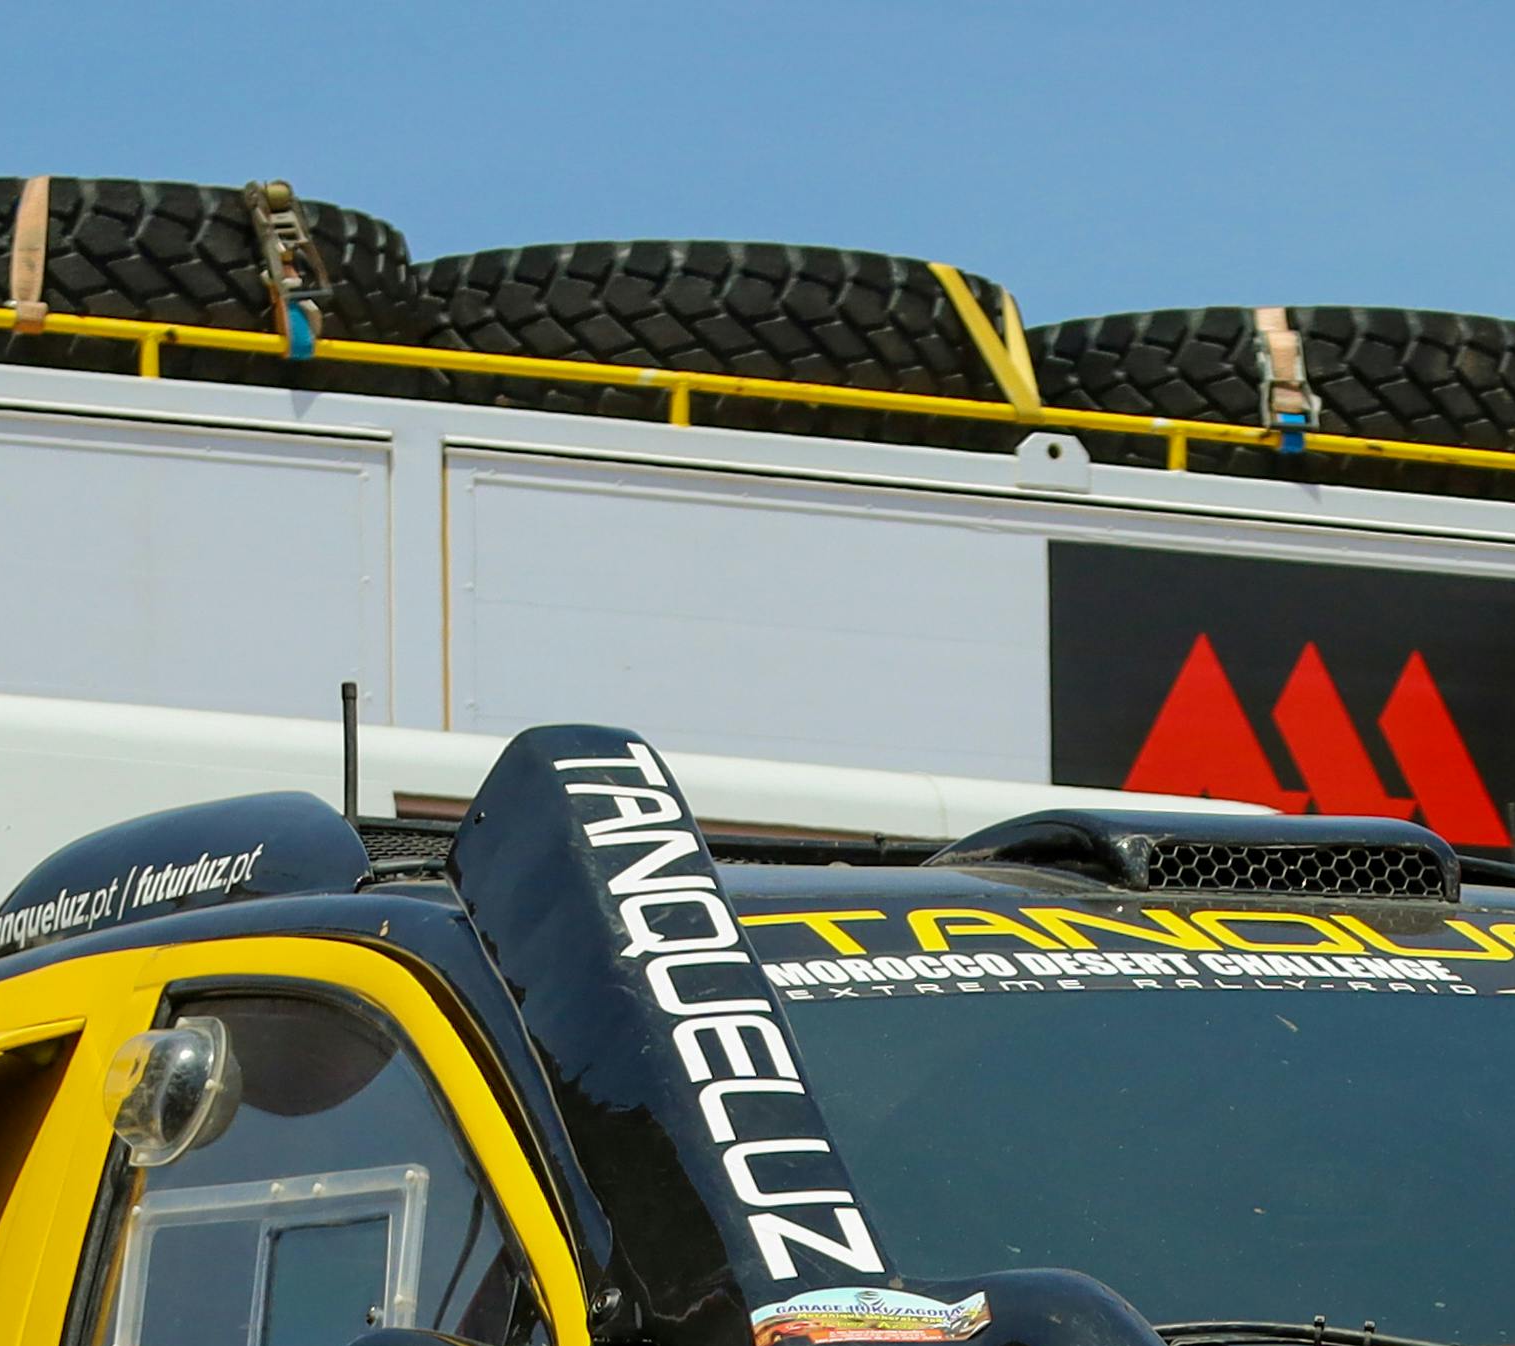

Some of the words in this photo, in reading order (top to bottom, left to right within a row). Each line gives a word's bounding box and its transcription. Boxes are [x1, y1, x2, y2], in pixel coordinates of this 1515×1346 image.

[133, 843, 264, 908] futurluz.pt
[766, 953, 1012, 989] MOROCCO
[1014, 950, 1190, 980] DESERT
[1200, 951, 1462, 983] CHALLENGE
[786, 978, 1085, 1000] EXTREME
[1134, 977, 1478, 996] RALLY-RAID
[552, 741, 885, 1280] TANQUELUZ
[776, 1303, 844, 1314] GARAGE
